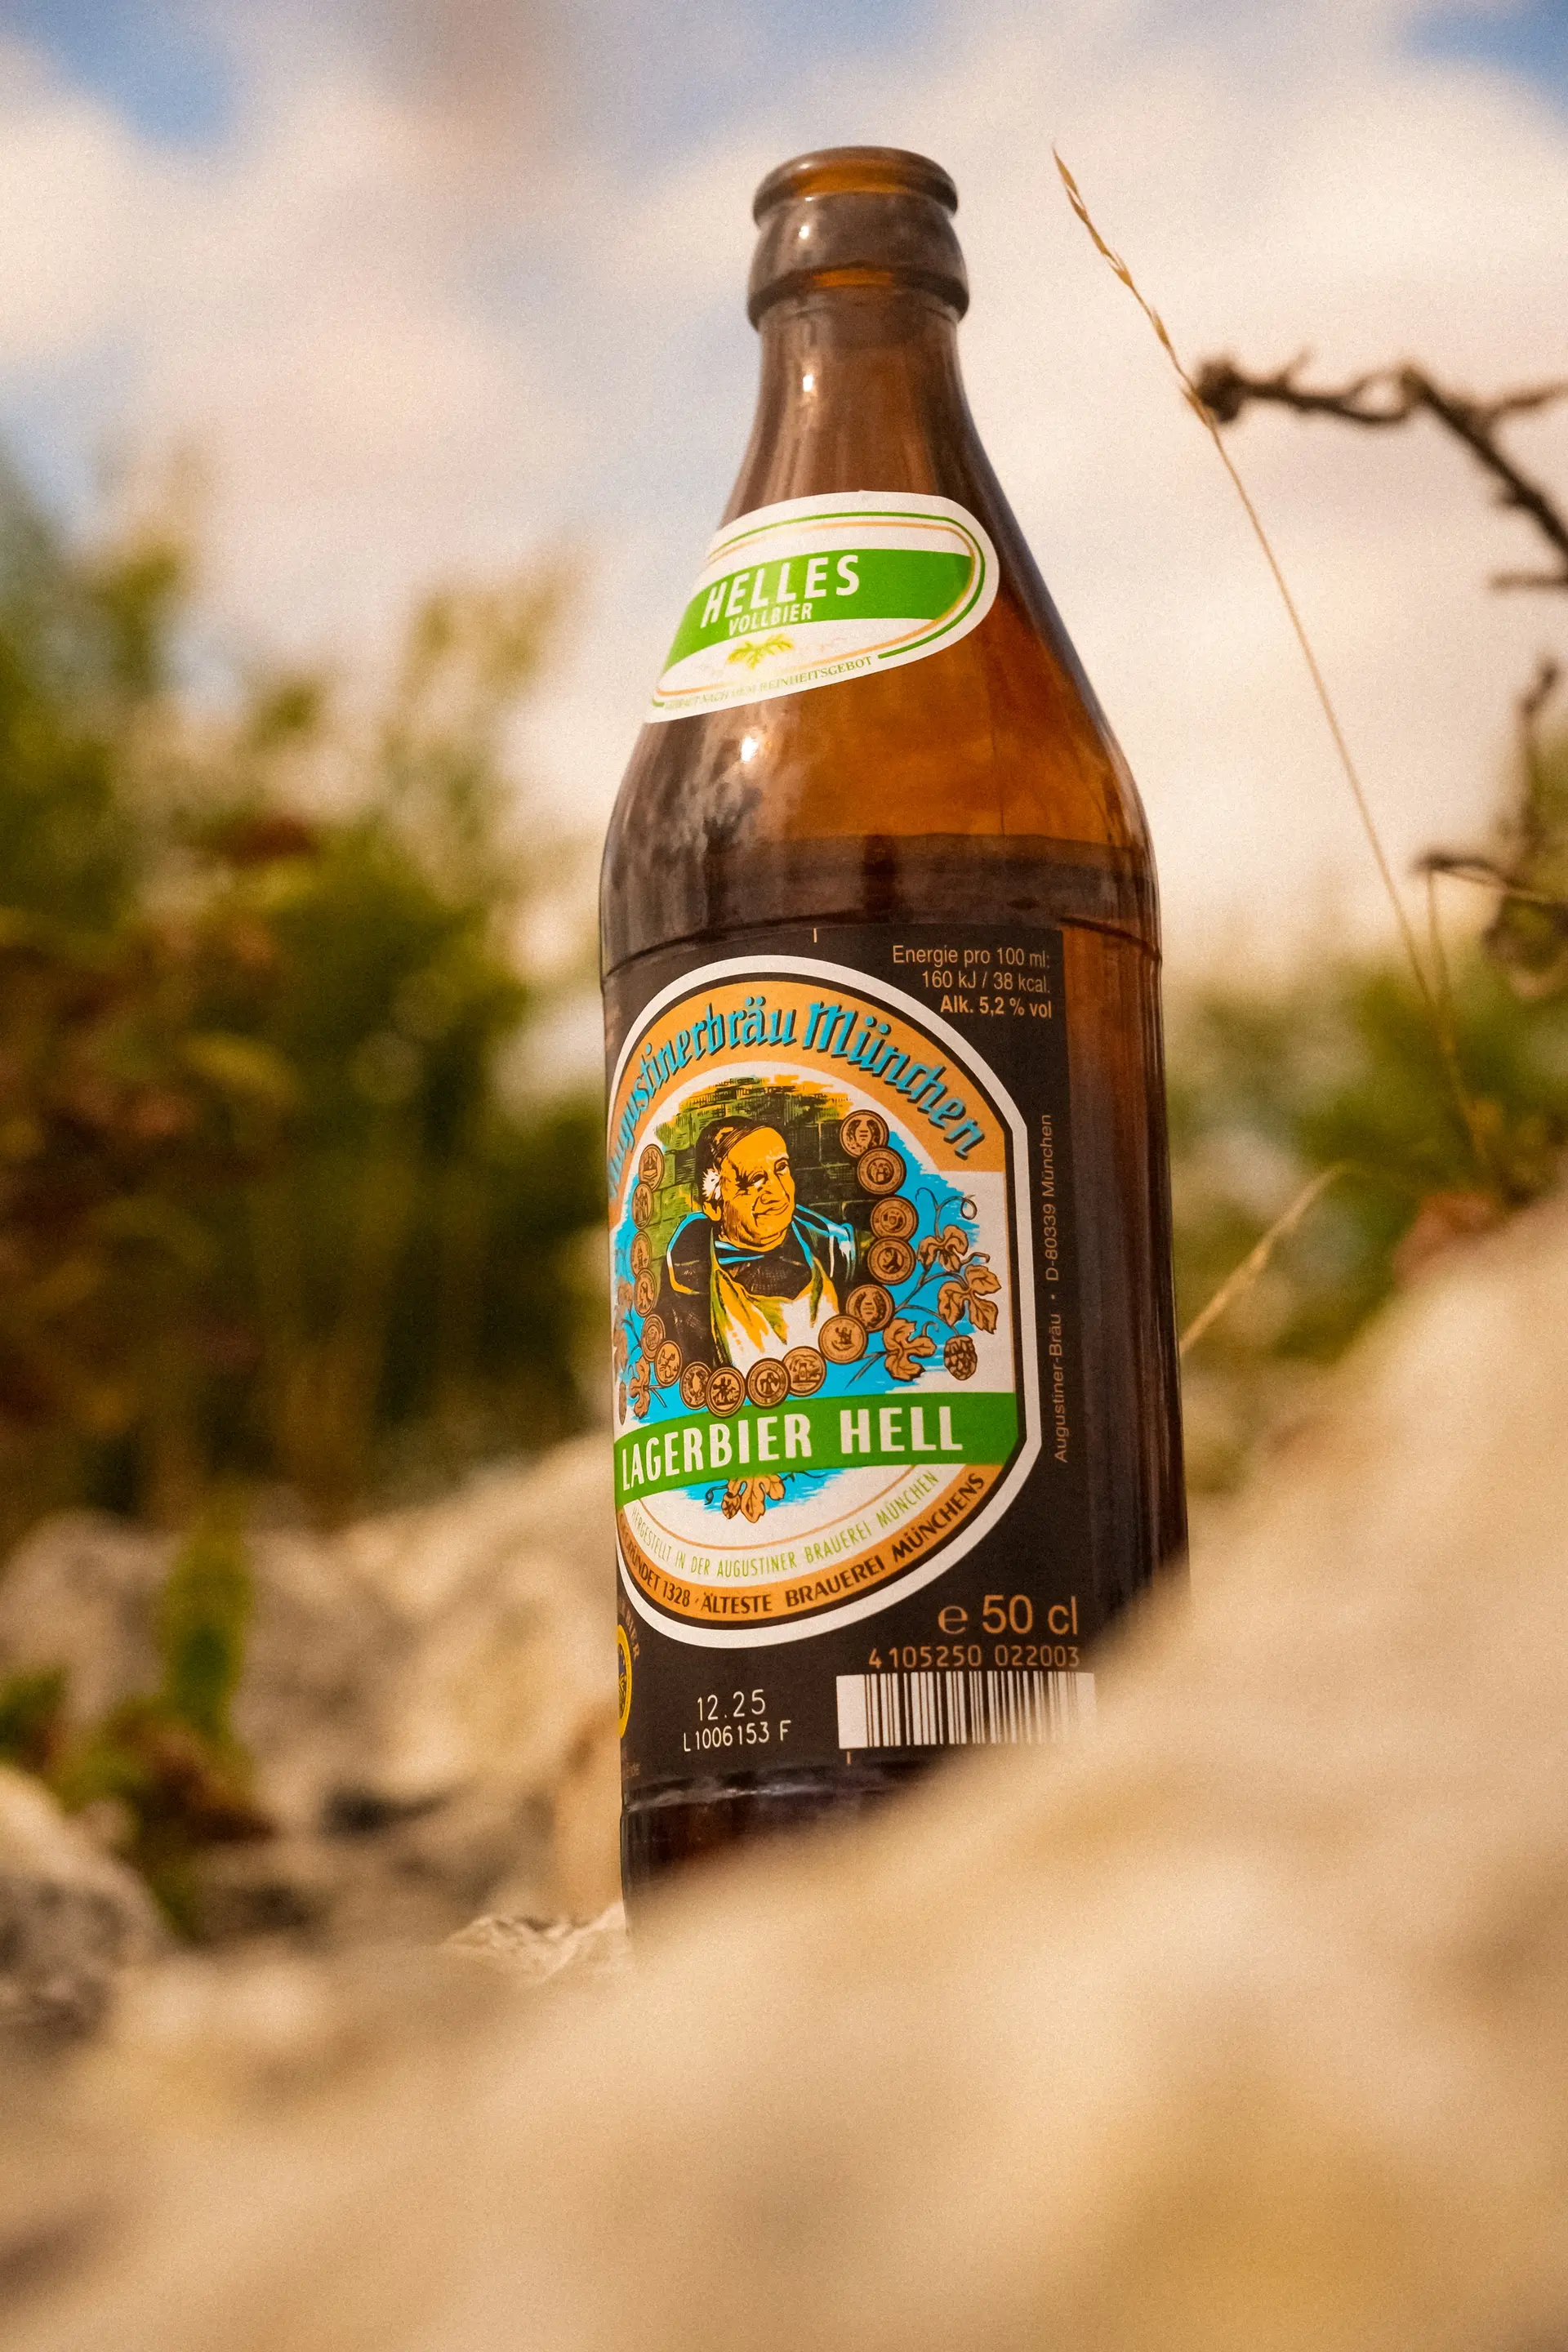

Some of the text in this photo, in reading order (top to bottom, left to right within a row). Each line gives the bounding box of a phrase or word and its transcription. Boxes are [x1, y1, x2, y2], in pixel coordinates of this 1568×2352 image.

[700, 555, 860, 628] HELLES
[728, 602, 813, 636] VOLLBIER
[760, 655, 873, 691] REINHEITSGEBOT
[893, 945, 1050, 969] Energie pro 100 ml:
[922, 970, 1050, 993] 160 kJ / 38 kcal.
[940, 995, 1052, 1018] Alk. 5,2 % vol
[802, 1000, 985, 1161] München
[1041, 1114, 1071, 1463] Augustiner-Bräu D-80339 München
[621, 1405, 963, 1491] LAGERBIER HELL
[675, 1552, 686, 1569] IN
[691, 1556, 710, 1575] DER
[717, 1553, 797, 1578] AUGUSTINER
[804, 1520, 873, 1564] BRAUEREI
[875, 1470, 940, 1528] MÜNCHEN
[662, 1580, 691, 1607] 1328
[700, 1592, 773, 1614] ÄLTESTE
[785, 1554, 886, 1608] BRAUEREI
[892, 1472, 985, 1563] MÜNCHENS
[982, 1594, 1034, 1635] 50
[1048, 1596, 1078, 1636] cl
[868, 1645, 1080, 1669] 4 105250 022003
[697, 1688, 767, 1722] 12.25
[779, 1720, 791, 1742] F
